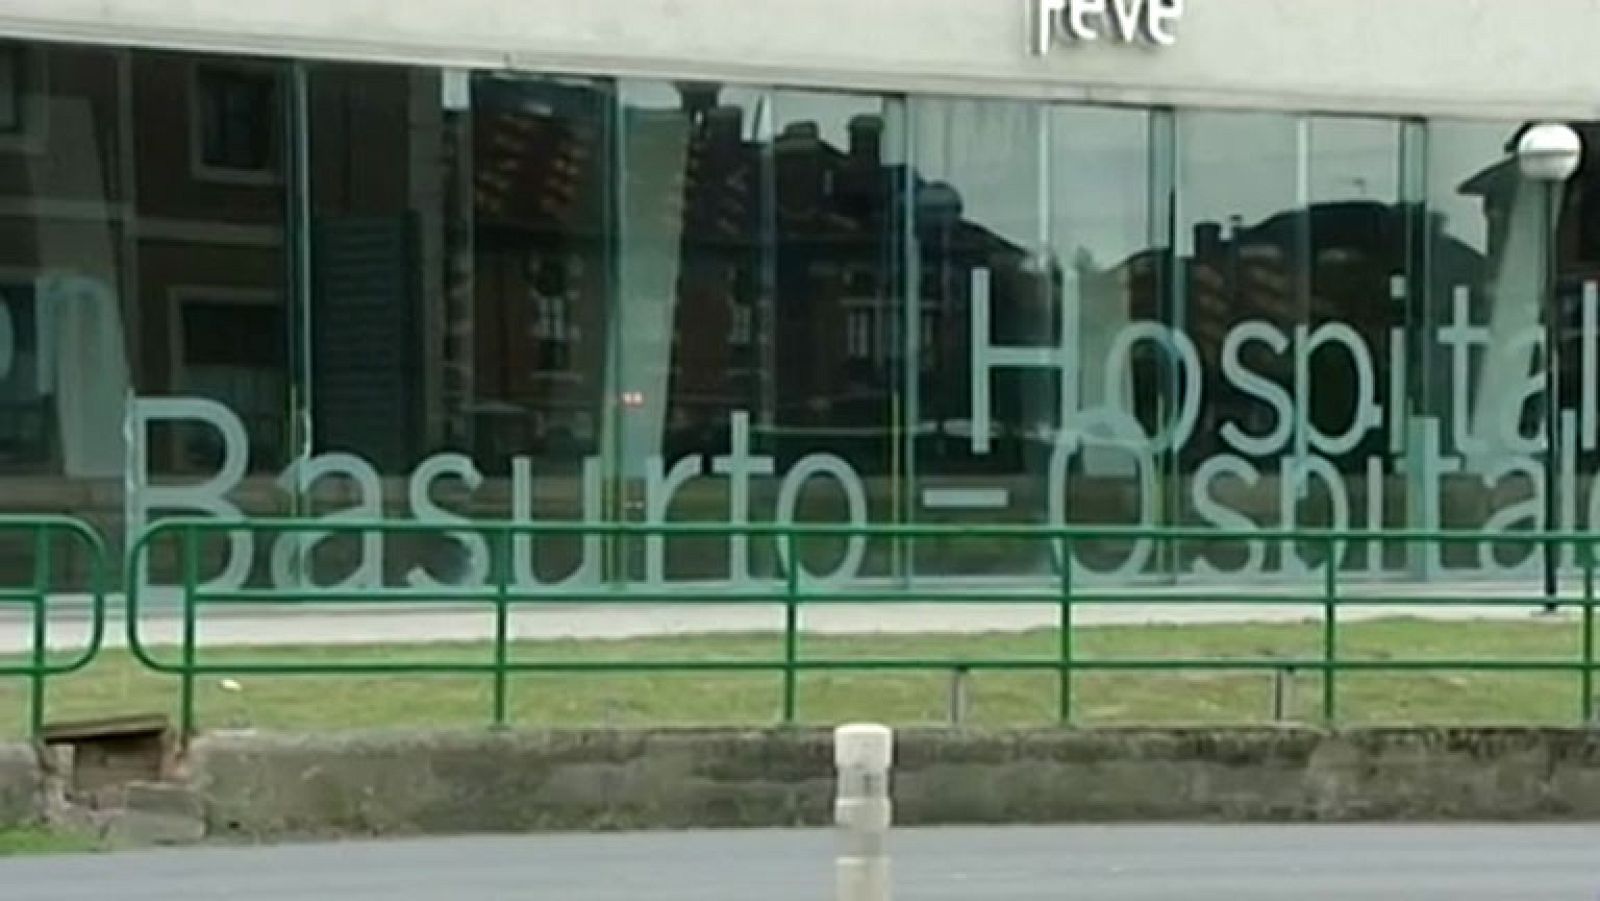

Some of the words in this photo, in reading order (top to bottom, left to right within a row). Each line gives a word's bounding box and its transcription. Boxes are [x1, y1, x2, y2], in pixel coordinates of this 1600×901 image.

[971, 266, 1598, 495] Hospital
[125, 396, 868, 591] Basurto
[1048, 405, 1600, 579] Ospital
